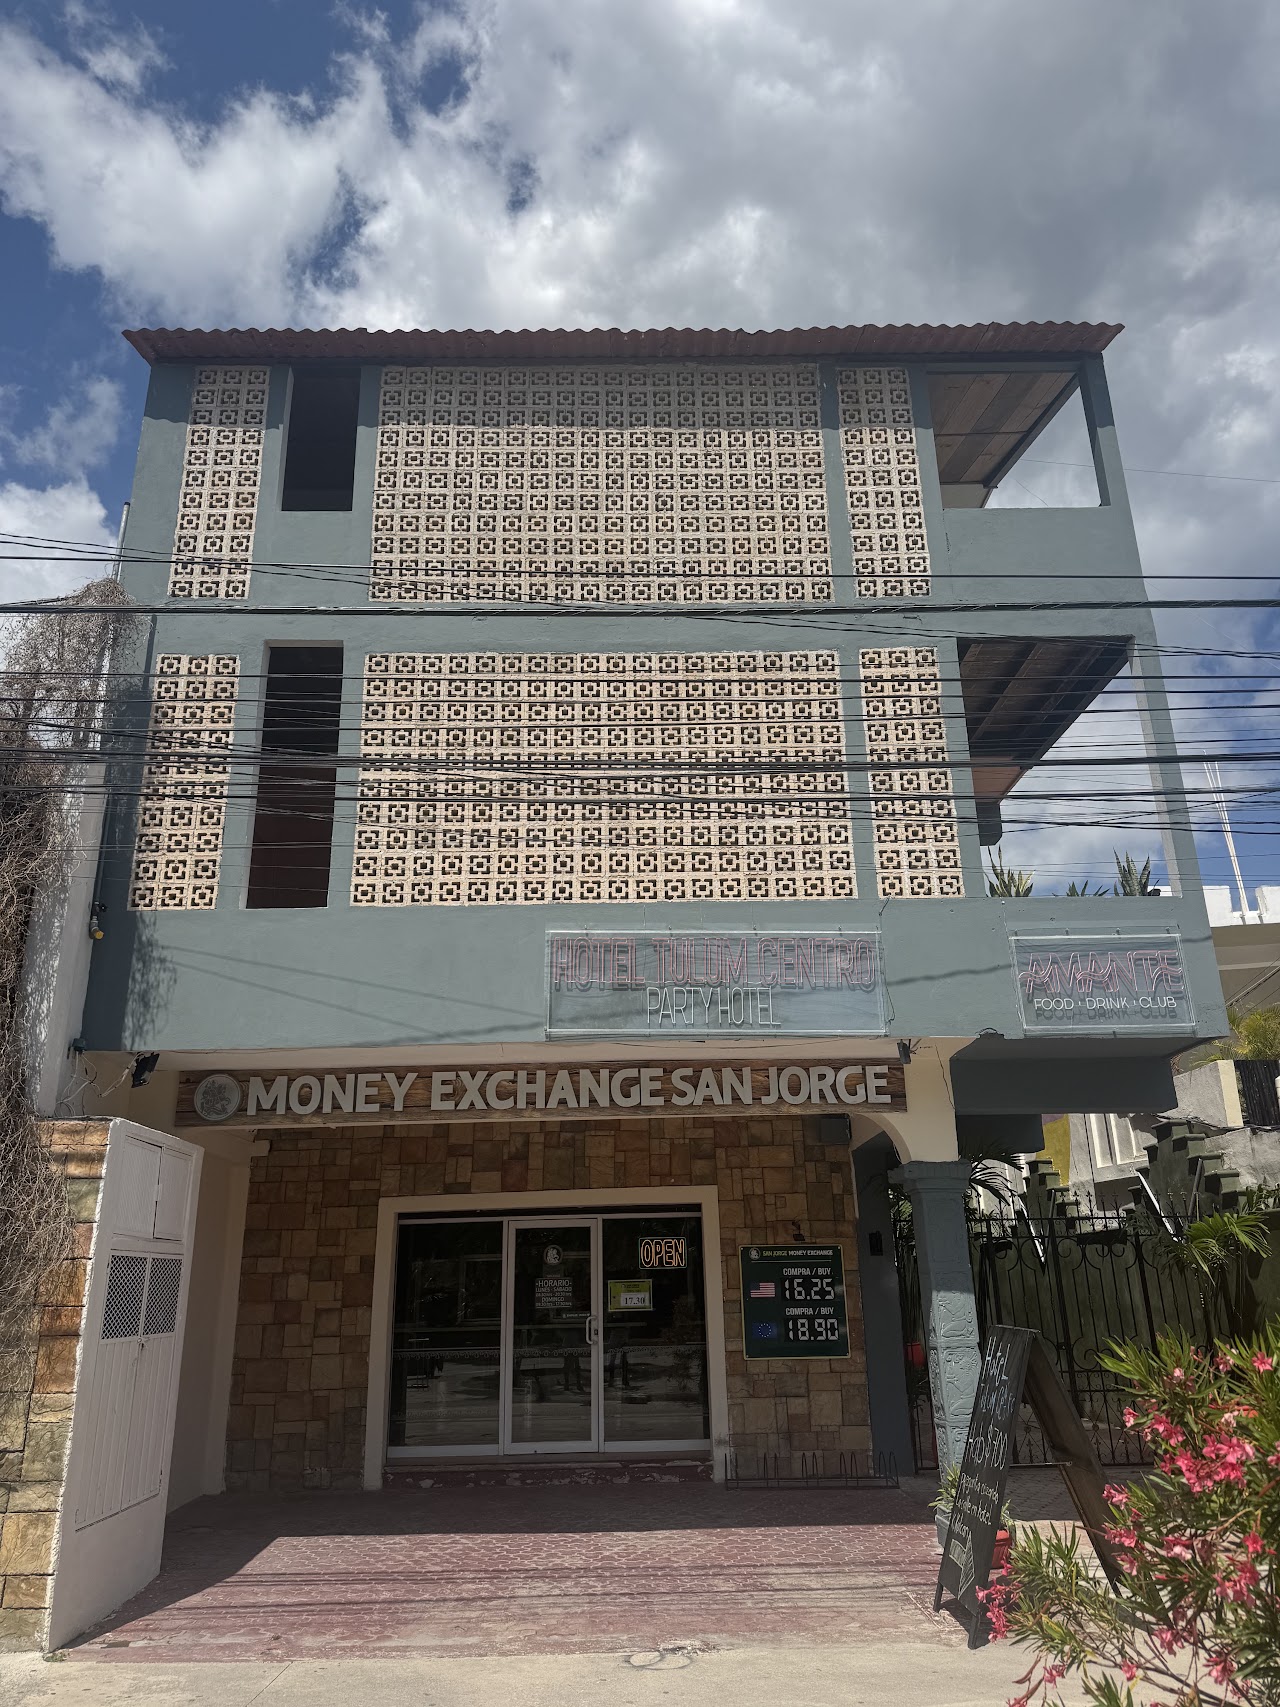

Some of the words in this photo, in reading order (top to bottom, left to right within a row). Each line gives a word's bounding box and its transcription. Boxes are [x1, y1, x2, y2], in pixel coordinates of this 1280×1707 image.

[552, 937, 645, 984] HOTEL
[654, 937, 747, 986] TULUM
[758, 937, 876, 986] CENTRO
[1018, 950, 1184, 993] AMANTE
[647, 987, 710, 1024] PARTY
[719, 987, 781, 1026] HOTEL
[1034, 998, 1075, 1010] FOOD
[1086, 997, 1129, 1009] DRINK
[1139, 996, 1177, 1008] CLUB
[246, 1072, 419, 1116] MONEY
[431, 1069, 665, 1112] EXCHANGE
[671, 1066, 754, 1105] SAN
[761, 1065, 892, 1105] JORGE
[640, 1239, 686, 1267] OPEN
[773, 1250, 788, 1258] JORGE
[783, 1267, 811, 1276] COMPRA
[817, 1267, 832, 1275] BUY
[784, 1278, 835, 1300] 16.25
[624, 1297, 646, 1305] 17.30
[785, 1307, 814, 1316] COMPRA
[820, 1306, 835, 1315] BUY
[788, 1318, 839, 1341] 18.90
